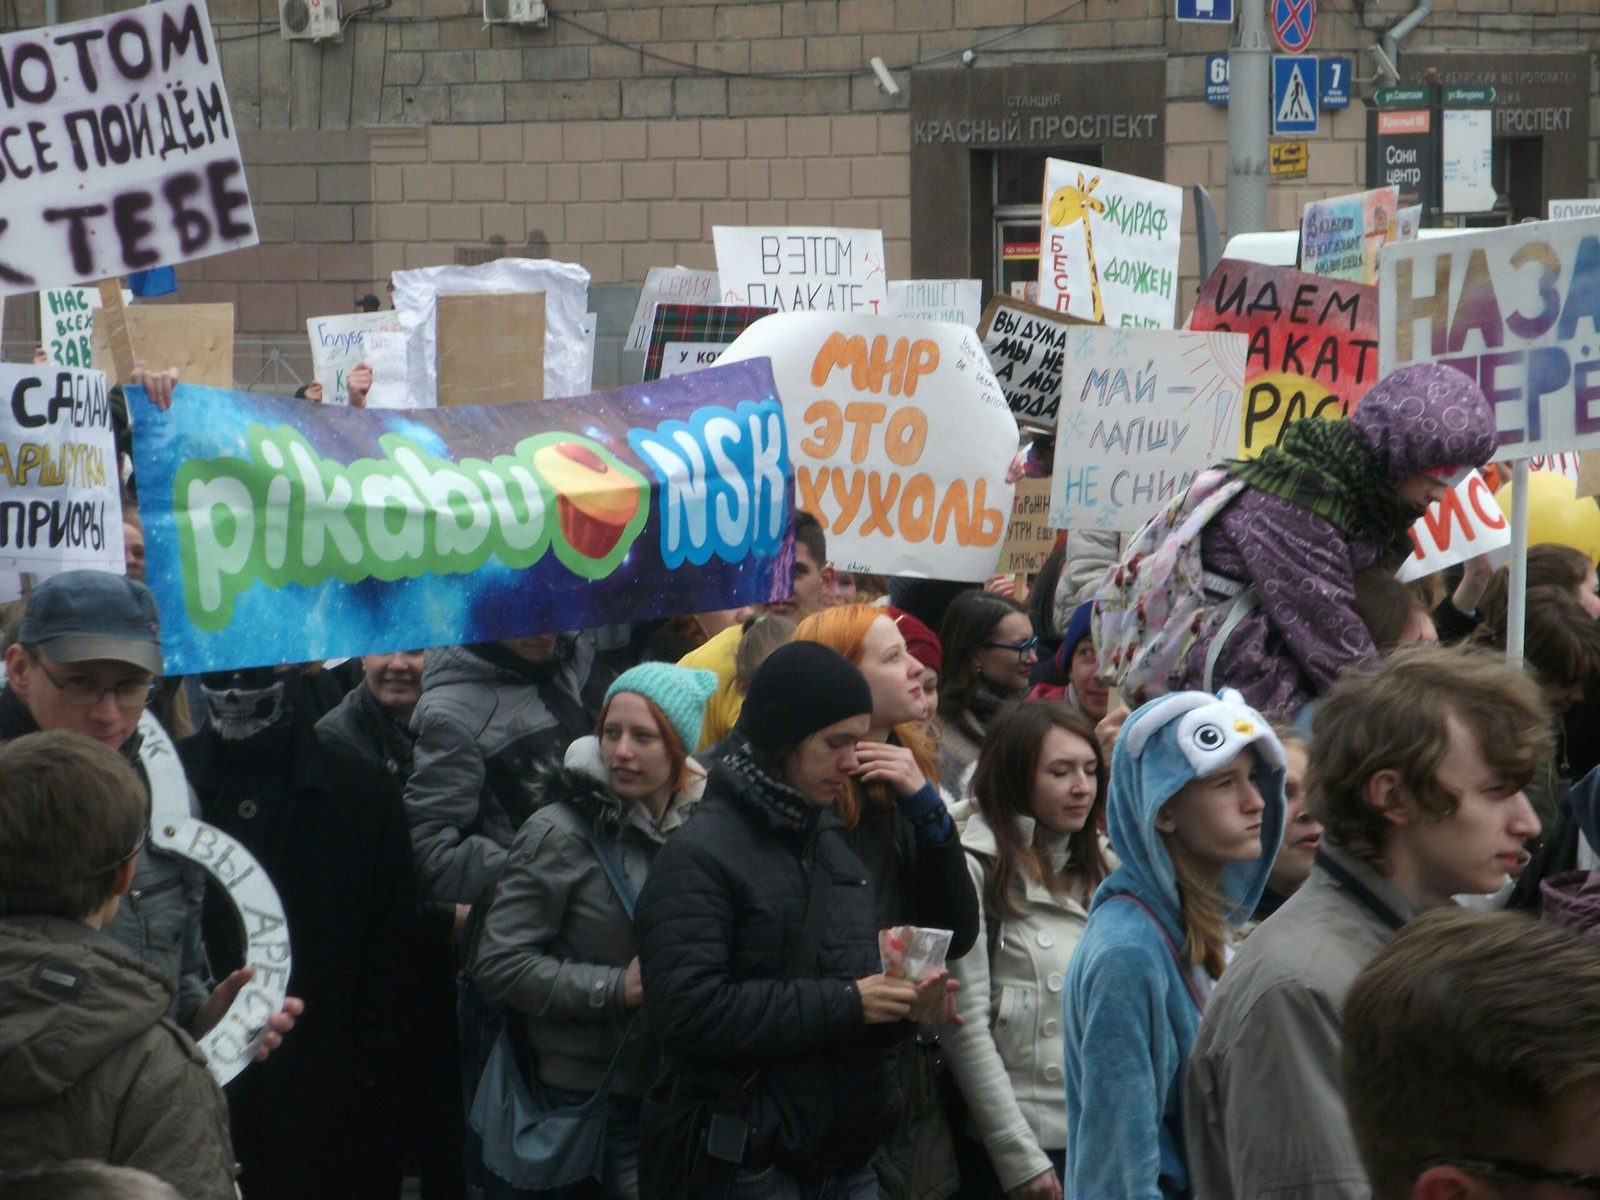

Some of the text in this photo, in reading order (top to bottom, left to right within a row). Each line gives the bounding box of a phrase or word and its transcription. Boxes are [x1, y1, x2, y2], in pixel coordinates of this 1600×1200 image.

[0, 3, 208, 109] ОТОМ
[1210, 57, 1228, 84] 6
[1331, 62, 1342, 88] 7
[1007, 93, 1061, 108] СТАНЦИЯ
[0, 80, 230, 181] СЕ ПОЙДЁМ
[914, 112, 1158, 144] КРАСНЫЙ ПРОСПЕКТ
[1495, 107, 1573, 132] ПРОСПЕКТ
[1386, 145, 1416, 165] Сони
[1386, 168, 1421, 187] центр
[42, 157, 252, 278] ТЕБЕ
[1102, 194, 1169, 240] ЖИРАФ
[760, 236, 852, 276] В ЭТОМ
[658, 275, 711, 298] СЕРИЯ
[905, 281, 961, 308] ПИШЕТ
[1103, 257, 1173, 299] ДОЛЖЕН
[48, 290, 88, 315] НАС
[747, 282, 864, 314] ПЛАКАТЕ
[1215, 274, 1360, 331] ИДЕМ
[56, 314, 93, 336] ВСЕХ
[993, 310, 1021, 337] ВЫ
[51, 335, 94, 368] ЗАВ
[697, 351, 722, 363] КО
[990, 338, 1064, 374] МЫ НЕ
[1215, 323, 1378, 384] АКАТ
[996, 362, 1014, 382] А
[1018, 371, 1063, 395] МЫ
[1080, 360, 1159, 407] МАЙ
[11, 372, 113, 432] СДЕЛАЙ
[1001, 387, 1061, 419] ЮДА
[1245, 383, 1348, 448] РА
[800, 400, 928, 467] ЭТО
[1089, 417, 1190, 455] ЛАПШУ
[1065, 466, 1099, 507] НЕ
[0, 500, 105, 551] ПРИОРЫ
[187, 411, 783, 612] pikabu NSK
[797, 466, 1004, 548] ХУХОЛЬ
[188, 825, 255, 890] ВЫ
